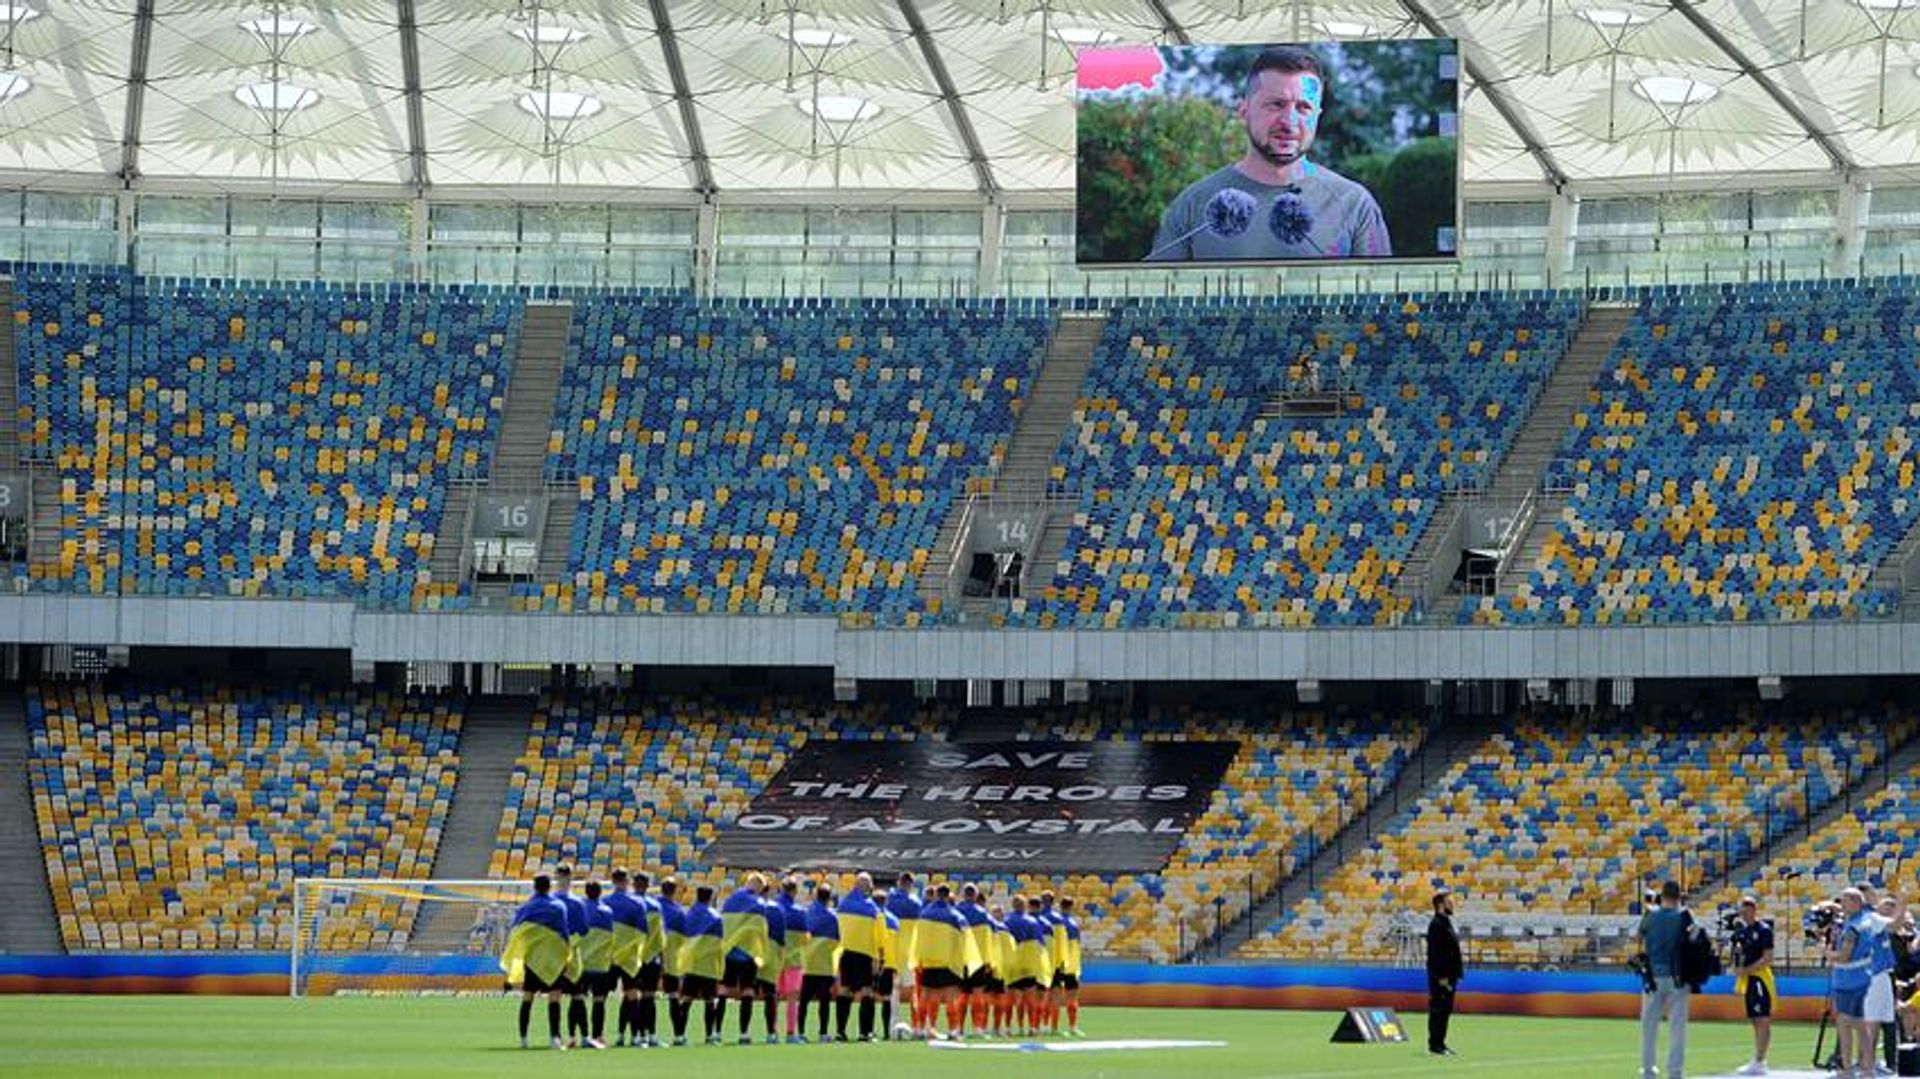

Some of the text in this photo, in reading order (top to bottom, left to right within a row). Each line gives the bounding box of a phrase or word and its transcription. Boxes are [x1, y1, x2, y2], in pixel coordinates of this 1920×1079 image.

[499, 505, 528, 527] 16
[996, 520, 1028, 543] 14
[927, 752, 1093, 769] SAVE
[789, 780, 1189, 801] THE HEROES
[737, 814, 1187, 835] OF AZOVSTAL
[836, 847, 1044, 860] #FREEAZOV
